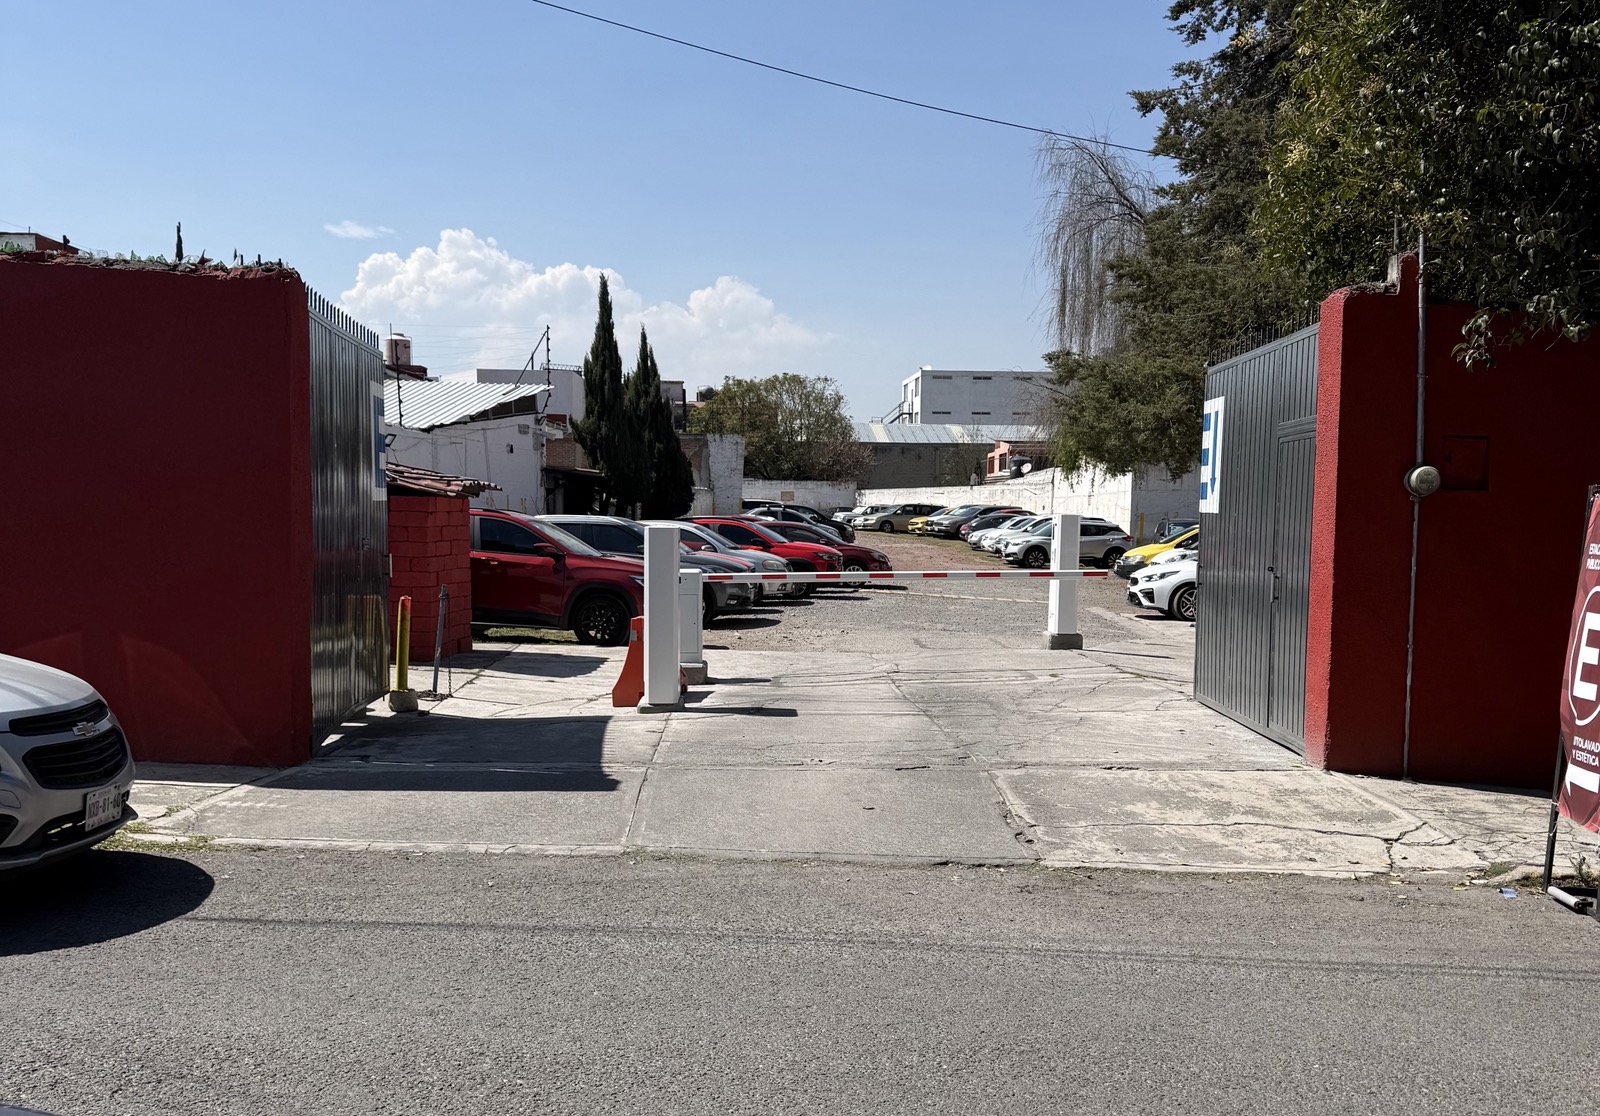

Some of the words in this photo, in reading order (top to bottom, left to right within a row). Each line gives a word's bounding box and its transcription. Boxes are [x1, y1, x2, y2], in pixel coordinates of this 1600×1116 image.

[1573, 612, 1600, 701] E
[1572, 749, 1576, 759] Y
[1575, 750, 1600, 767] ESTÉTICA
